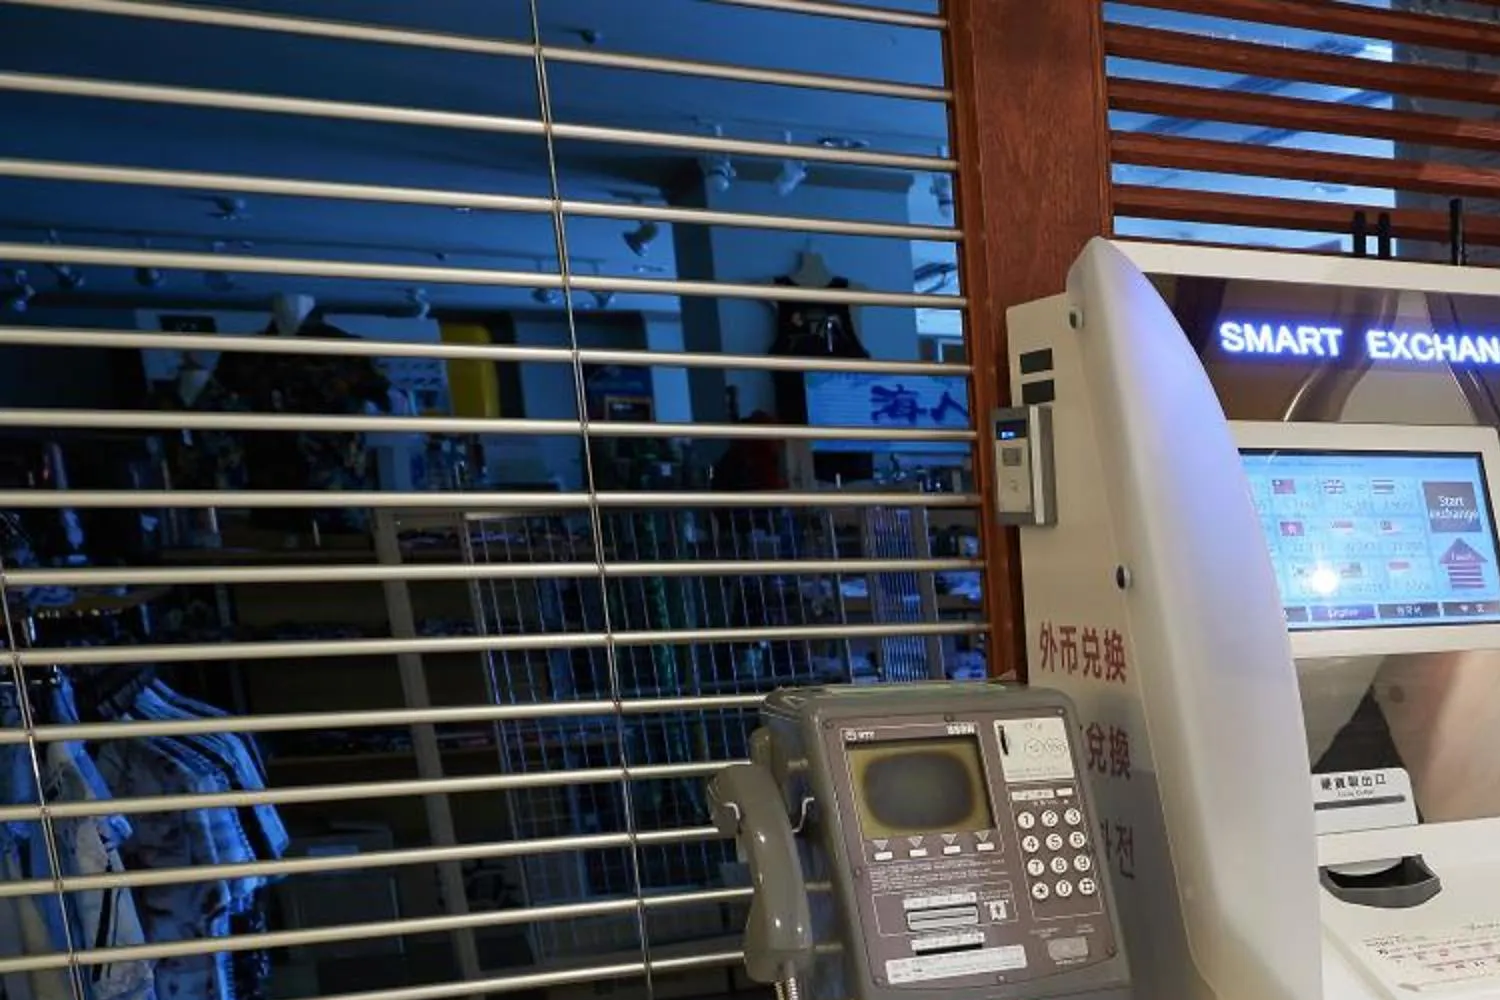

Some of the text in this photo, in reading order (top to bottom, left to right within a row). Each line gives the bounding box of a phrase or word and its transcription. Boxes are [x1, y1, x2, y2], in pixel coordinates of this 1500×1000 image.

[1219, 321, 1343, 357] SMART
[1438, 495, 1464, 506] Start
[1430, 508, 1479, 522] exchange
[1039, 620, 1127, 684] 外币兑换
